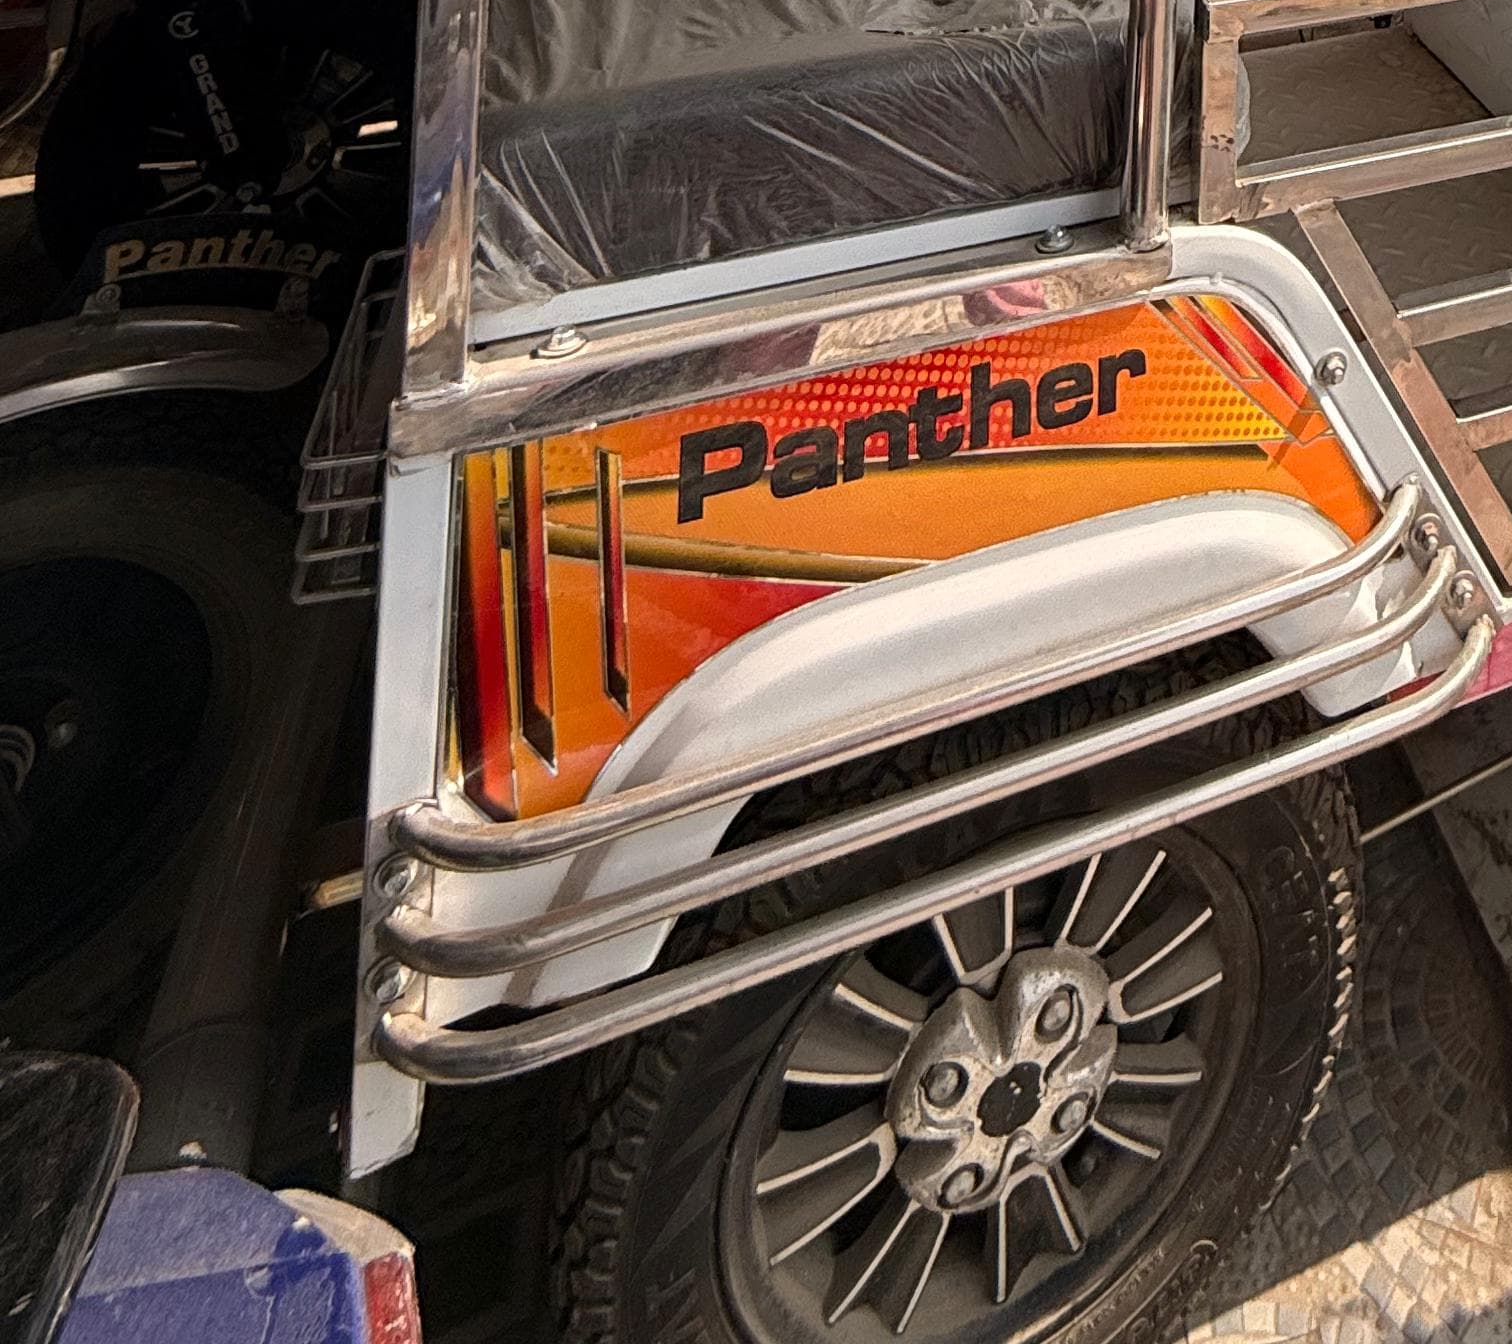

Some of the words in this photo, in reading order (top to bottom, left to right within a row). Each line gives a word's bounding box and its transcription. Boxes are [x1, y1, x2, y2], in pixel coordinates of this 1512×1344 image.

[188, 52, 241, 156] GRAND
[103, 219, 342, 284] Panther
[676, 348, 1147, 524] Panther
